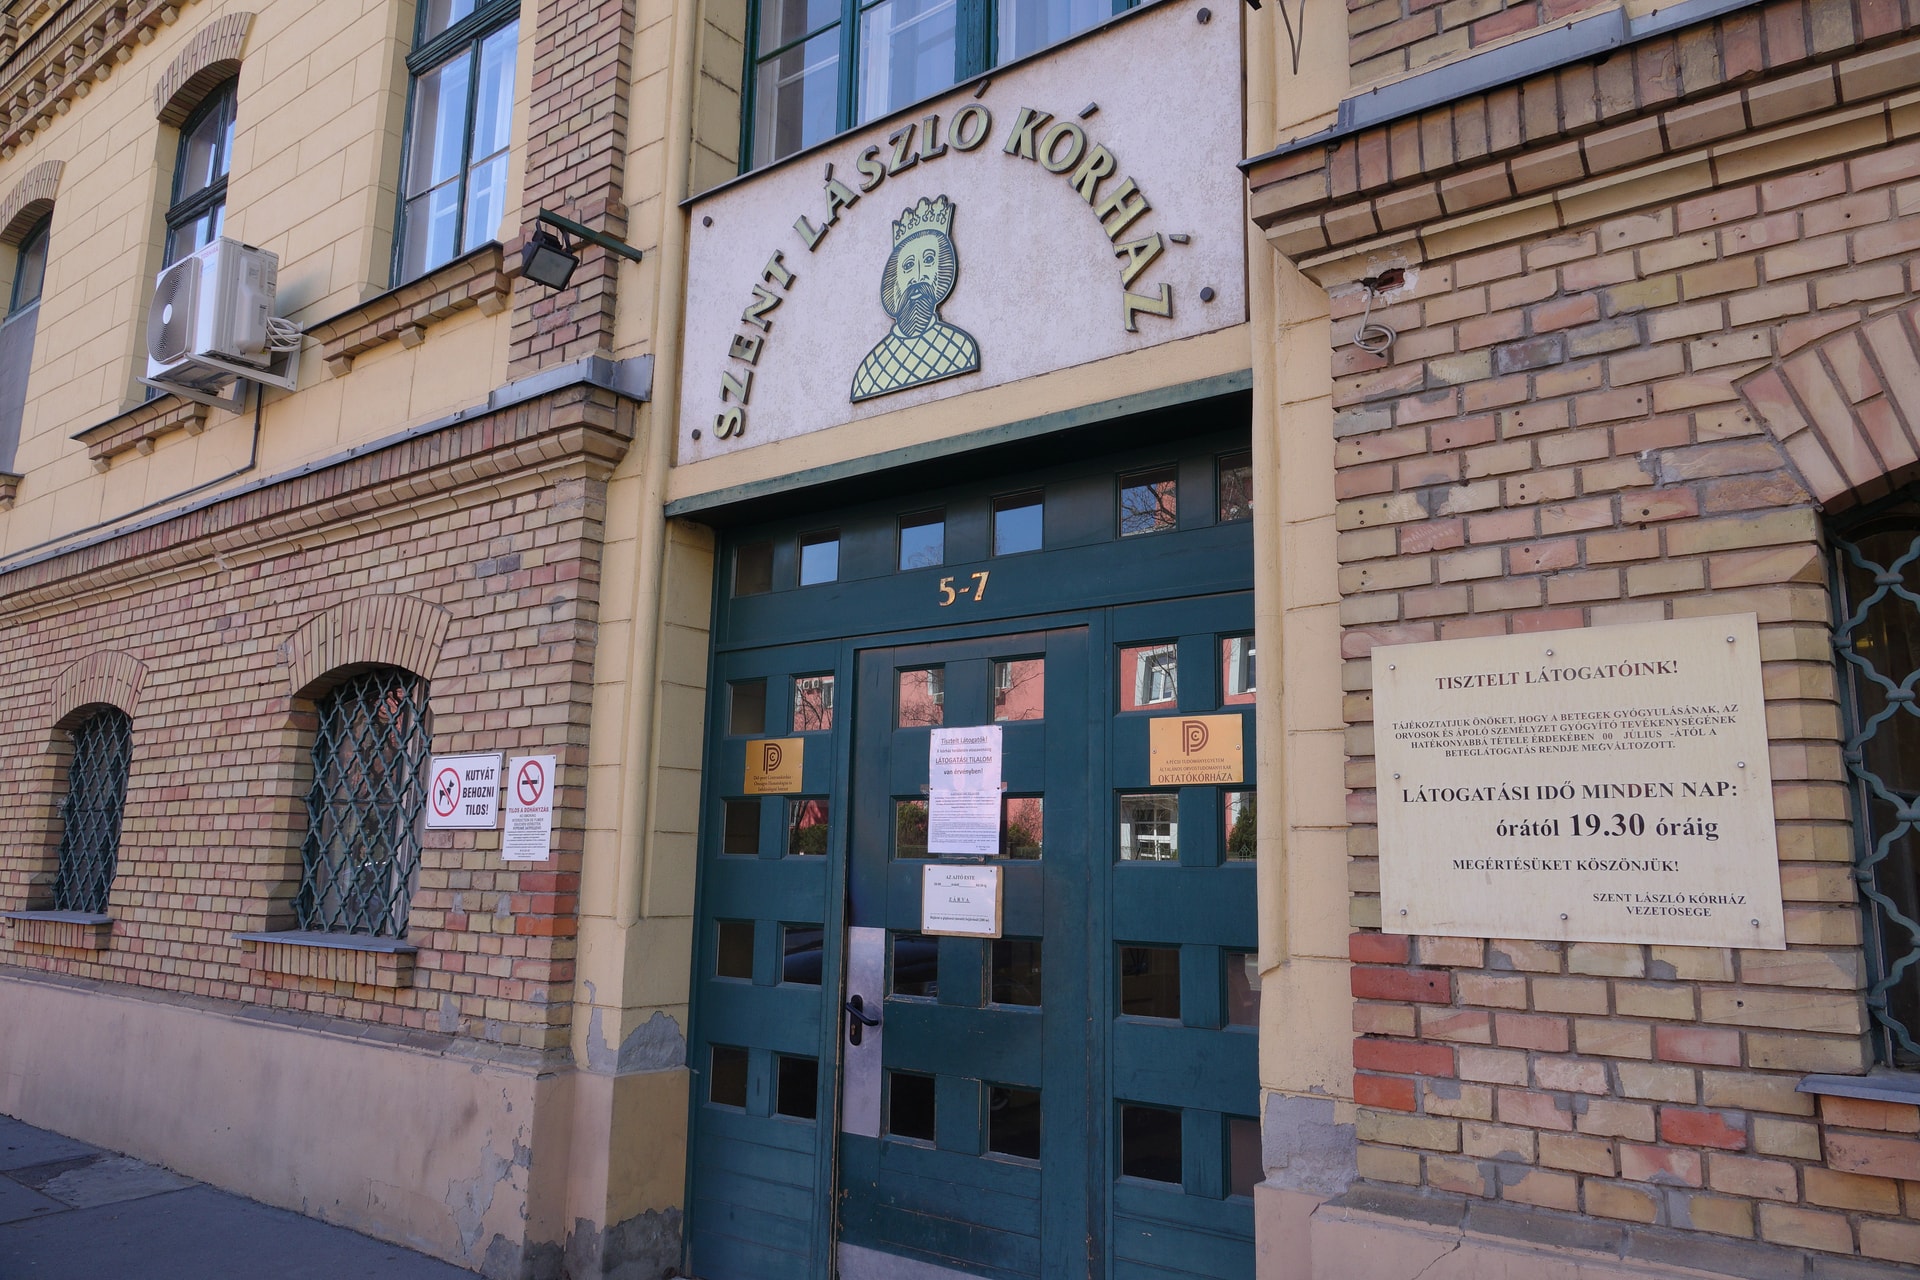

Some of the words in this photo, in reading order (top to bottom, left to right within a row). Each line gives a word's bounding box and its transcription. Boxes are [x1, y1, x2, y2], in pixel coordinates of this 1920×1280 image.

[712, 248, 797, 440] SZENT
[792, 79, 992, 252] LÁSZLÓ
[1003, 101, 1190, 333] KÓRHÁZ
[938, 570, 991, 607] 5-7
[1435, 671, 1520, 690] TISZTELT
[1525, 660, 1678, 685] LÁTOGATÓINK!
[1392, 718, 1471, 730] TÁJÉKOZTATJUK
[1518, 714, 1549, 724] HOGY
[1551, 714, 1558, 722] A
[1560, 711, 1611, 721] BETEGEK
[1613, 704, 1720, 719] GYÓGYULÁSÁNAK,
[1722, 703, 1739, 713] AZ
[1395, 730, 1440, 740] ORVOSOK
[1442, 728, 1454, 738] ÉS
[1455, 726, 1489, 738] ÁPOLÓ
[1490, 723, 1558, 735] SZEMÉLYZET
[1559, 719, 1618, 732] GYÓGYÍTÓ
[1620, 714, 1737, 729] TEVÉKENYSÉGÉNEK
[1411, 738, 1488, 749] HATÉKONYABBÁ
[1531, 732, 1595, 744] ÉRDEKÉBEN
[1602, 732, 1613, 740] 00
[1623, 729, 1663, 740] JÚLIUS
[1670, 728, 1706, 738] -ÁTÓL
[1709, 727, 1717, 736] A
[1445, 745, 1536, 757] BETEGLÁTOGATÁS
[1538, 744, 1579, 754] RENDJE
[1581, 740, 1676, 752] MEGVÁLTOZOTT.
[465, 766, 495, 781] KUTYÁT
[1158, 771, 1233, 783] OKTATÓKÓRHÁZA
[462, 786, 495, 798] BEHOZNI
[1402, 784, 1530, 803] LÁTOGATÁSI
[1536, 780, 1575, 800] IDŐ
[1581, 782, 1674, 799] MINDEN
[1681, 781, 1738, 798] NAP:
[465, 804, 489, 815] TILOS!
[1495, 818, 1560, 837] órától
[1569, 813, 1645, 838] 19.30
[1655, 817, 1719, 841] óráig
[1452, 857, 1572, 871] MEGÉRTÉSÜKET
[1576, 858, 1680, 872] KÖSZÖNJÜK!
[1592, 892, 1632, 903] SZENT
[1635, 891, 1685, 904] LÁSZLÓ
[1688, 892, 1747, 905] KÓRHÁZ
